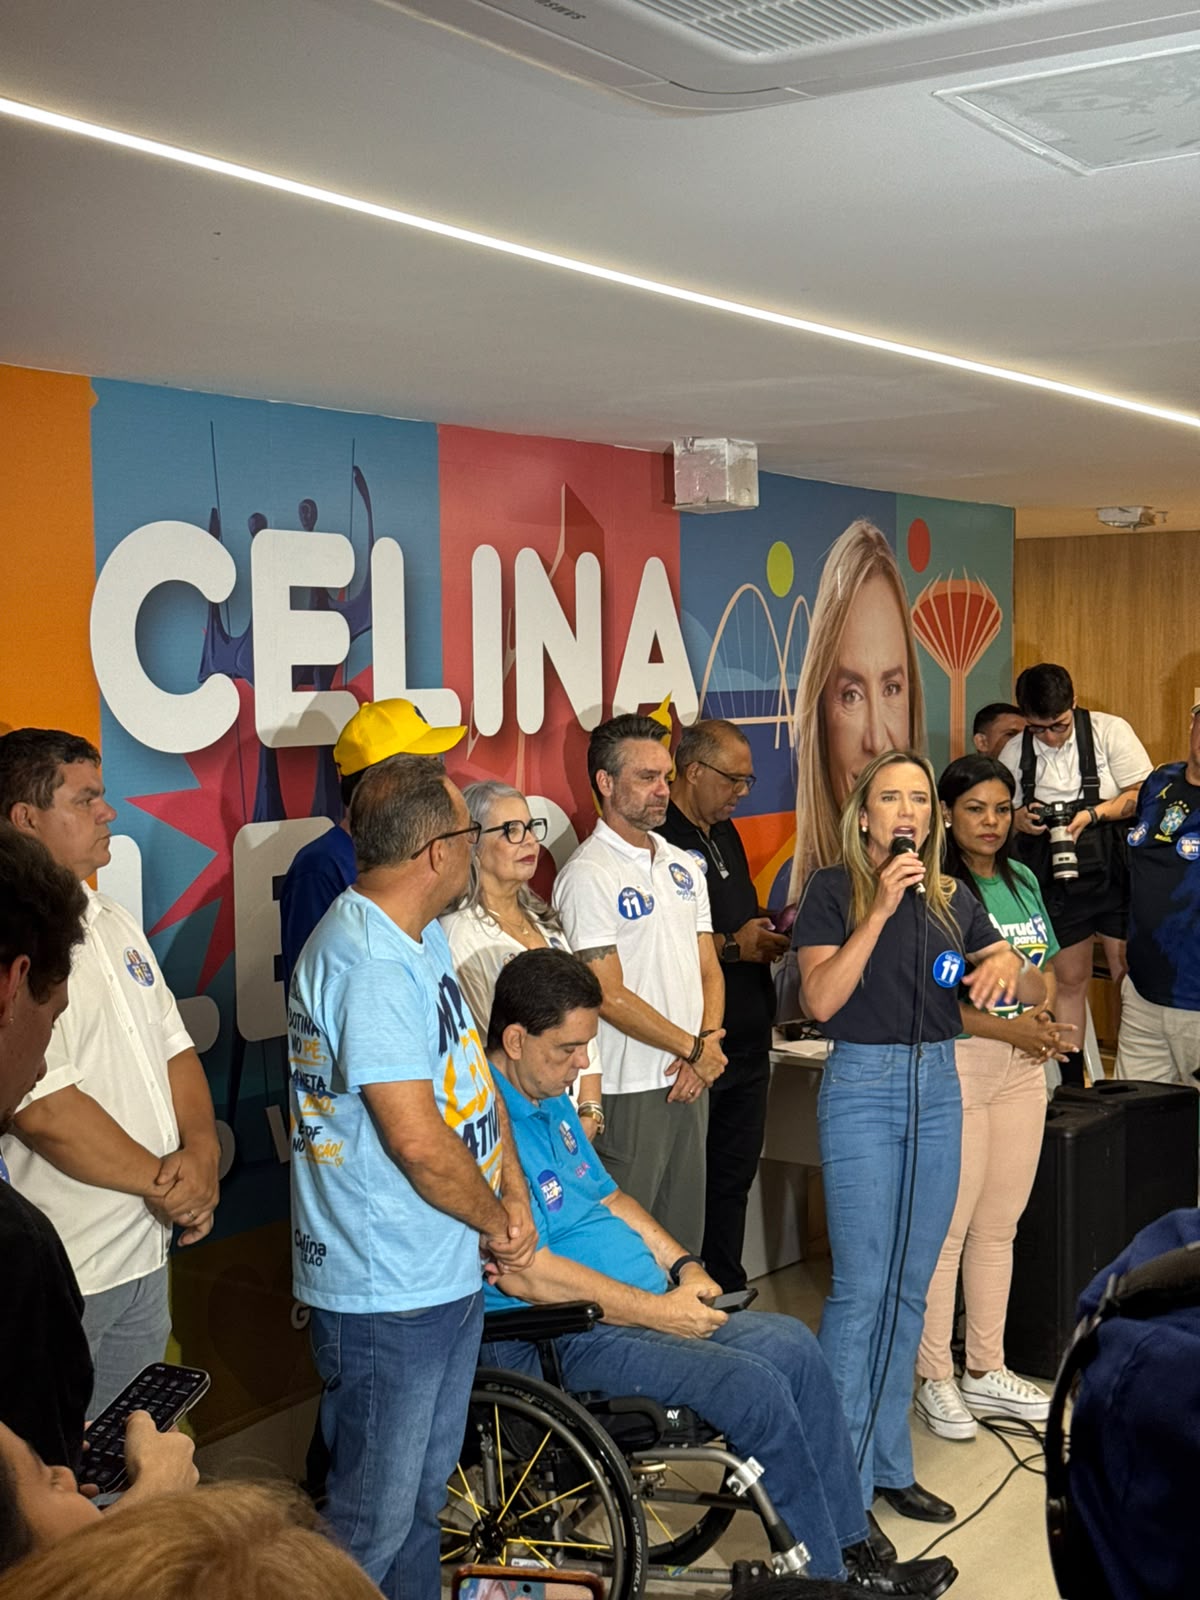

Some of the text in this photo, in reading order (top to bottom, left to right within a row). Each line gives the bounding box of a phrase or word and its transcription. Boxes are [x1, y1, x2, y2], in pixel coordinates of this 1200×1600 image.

[89, 520, 700, 754] CELINA
[622, 897, 642, 918] 11
[942, 960, 960, 984] 11
[664, 1409, 680, 1420] AY
